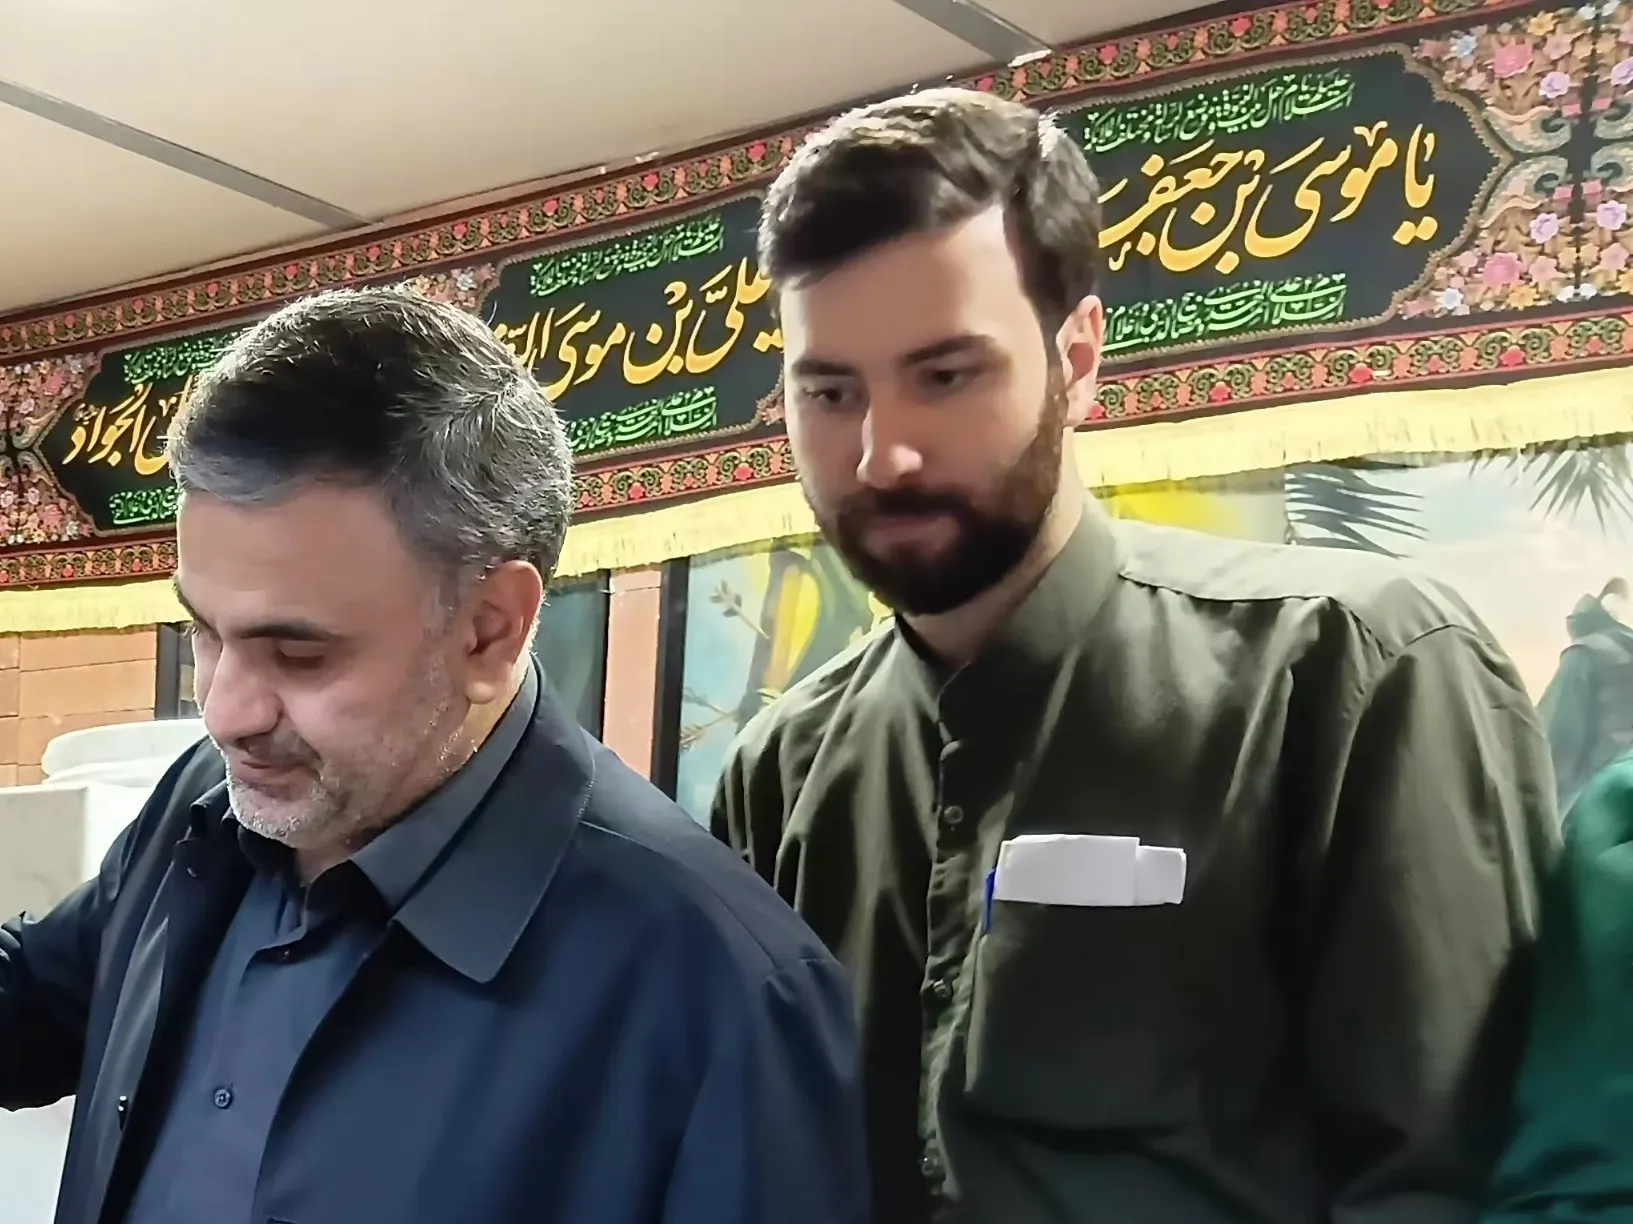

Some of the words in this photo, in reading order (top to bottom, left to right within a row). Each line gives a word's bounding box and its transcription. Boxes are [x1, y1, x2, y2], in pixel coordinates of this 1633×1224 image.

[1098, 150, 1244, 256] جعفر
[1159, 174, 1260, 275] بن
[1244, 136, 1398, 258] موسی
[1392, 122, 1438, 245] یا
[623, 299, 693, 384] بن
